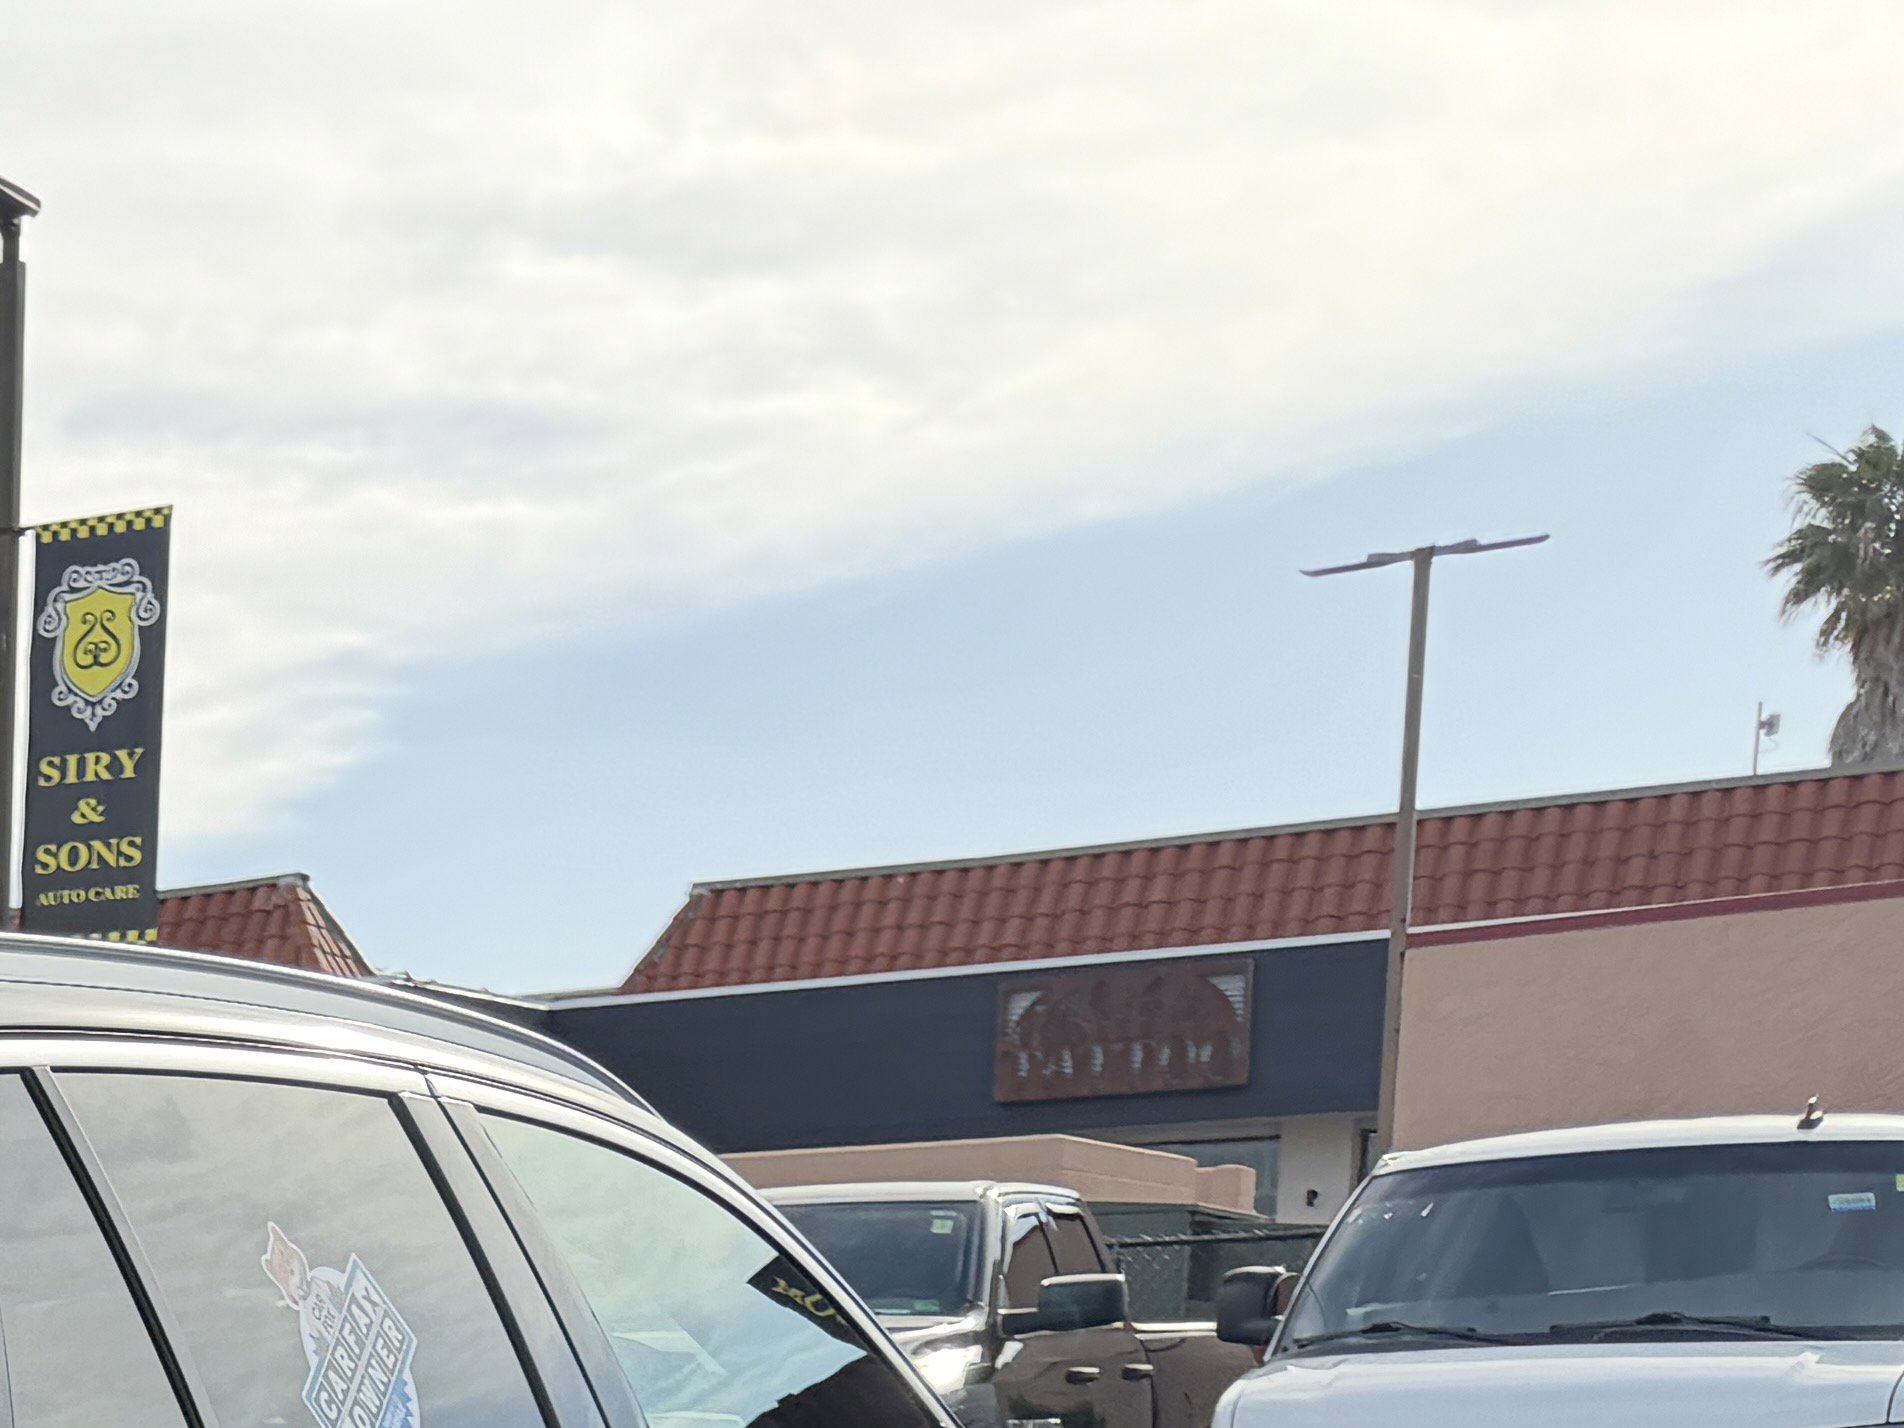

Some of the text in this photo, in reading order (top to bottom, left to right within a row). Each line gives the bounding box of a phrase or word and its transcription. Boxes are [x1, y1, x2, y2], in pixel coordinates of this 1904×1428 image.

[37, 747, 146, 788] SIRY
[70, 797, 107, 825] &
[33, 835, 144, 876] SONS
[38, 883, 141, 907] AUTO CARE
[318, 1286, 383, 1421] CARFAX
